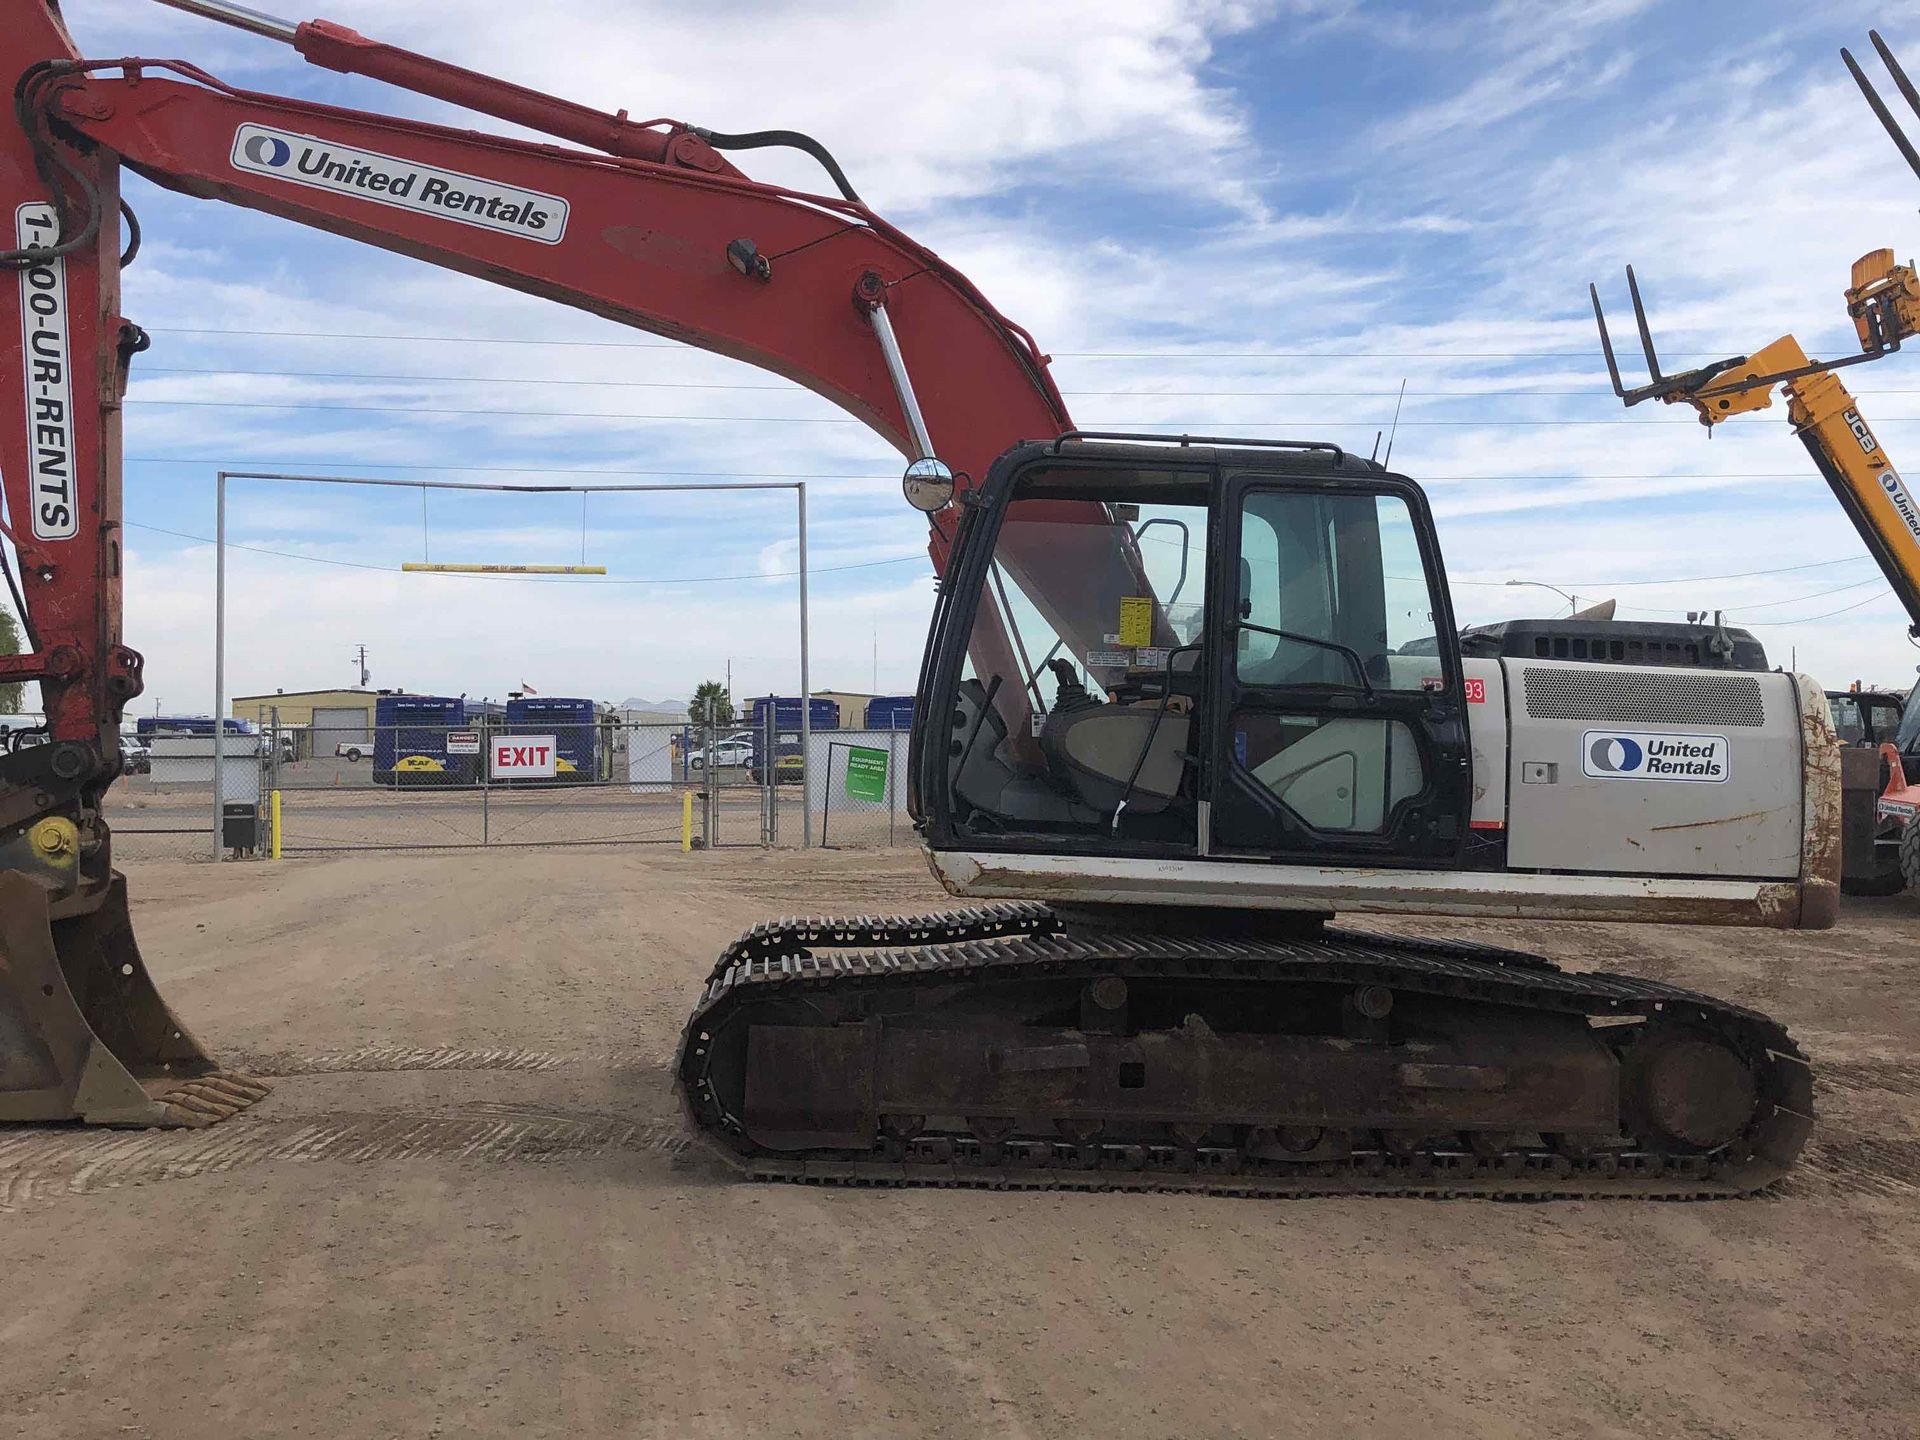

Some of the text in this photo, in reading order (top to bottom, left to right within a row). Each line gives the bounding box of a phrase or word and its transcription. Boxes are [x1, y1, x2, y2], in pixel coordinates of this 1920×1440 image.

[297, 147, 549, 230] United Rentals
[1842, 407, 1877, 454] JCB
[1464, 681, 1483, 699] 93
[498, 746, 550, 767] EXIT
[1647, 740, 1715, 758] United
[850, 762, 869, 770] READY
[851, 756, 884, 766] EQUIPMENT
[1646, 757, 1721, 776] Rentals
